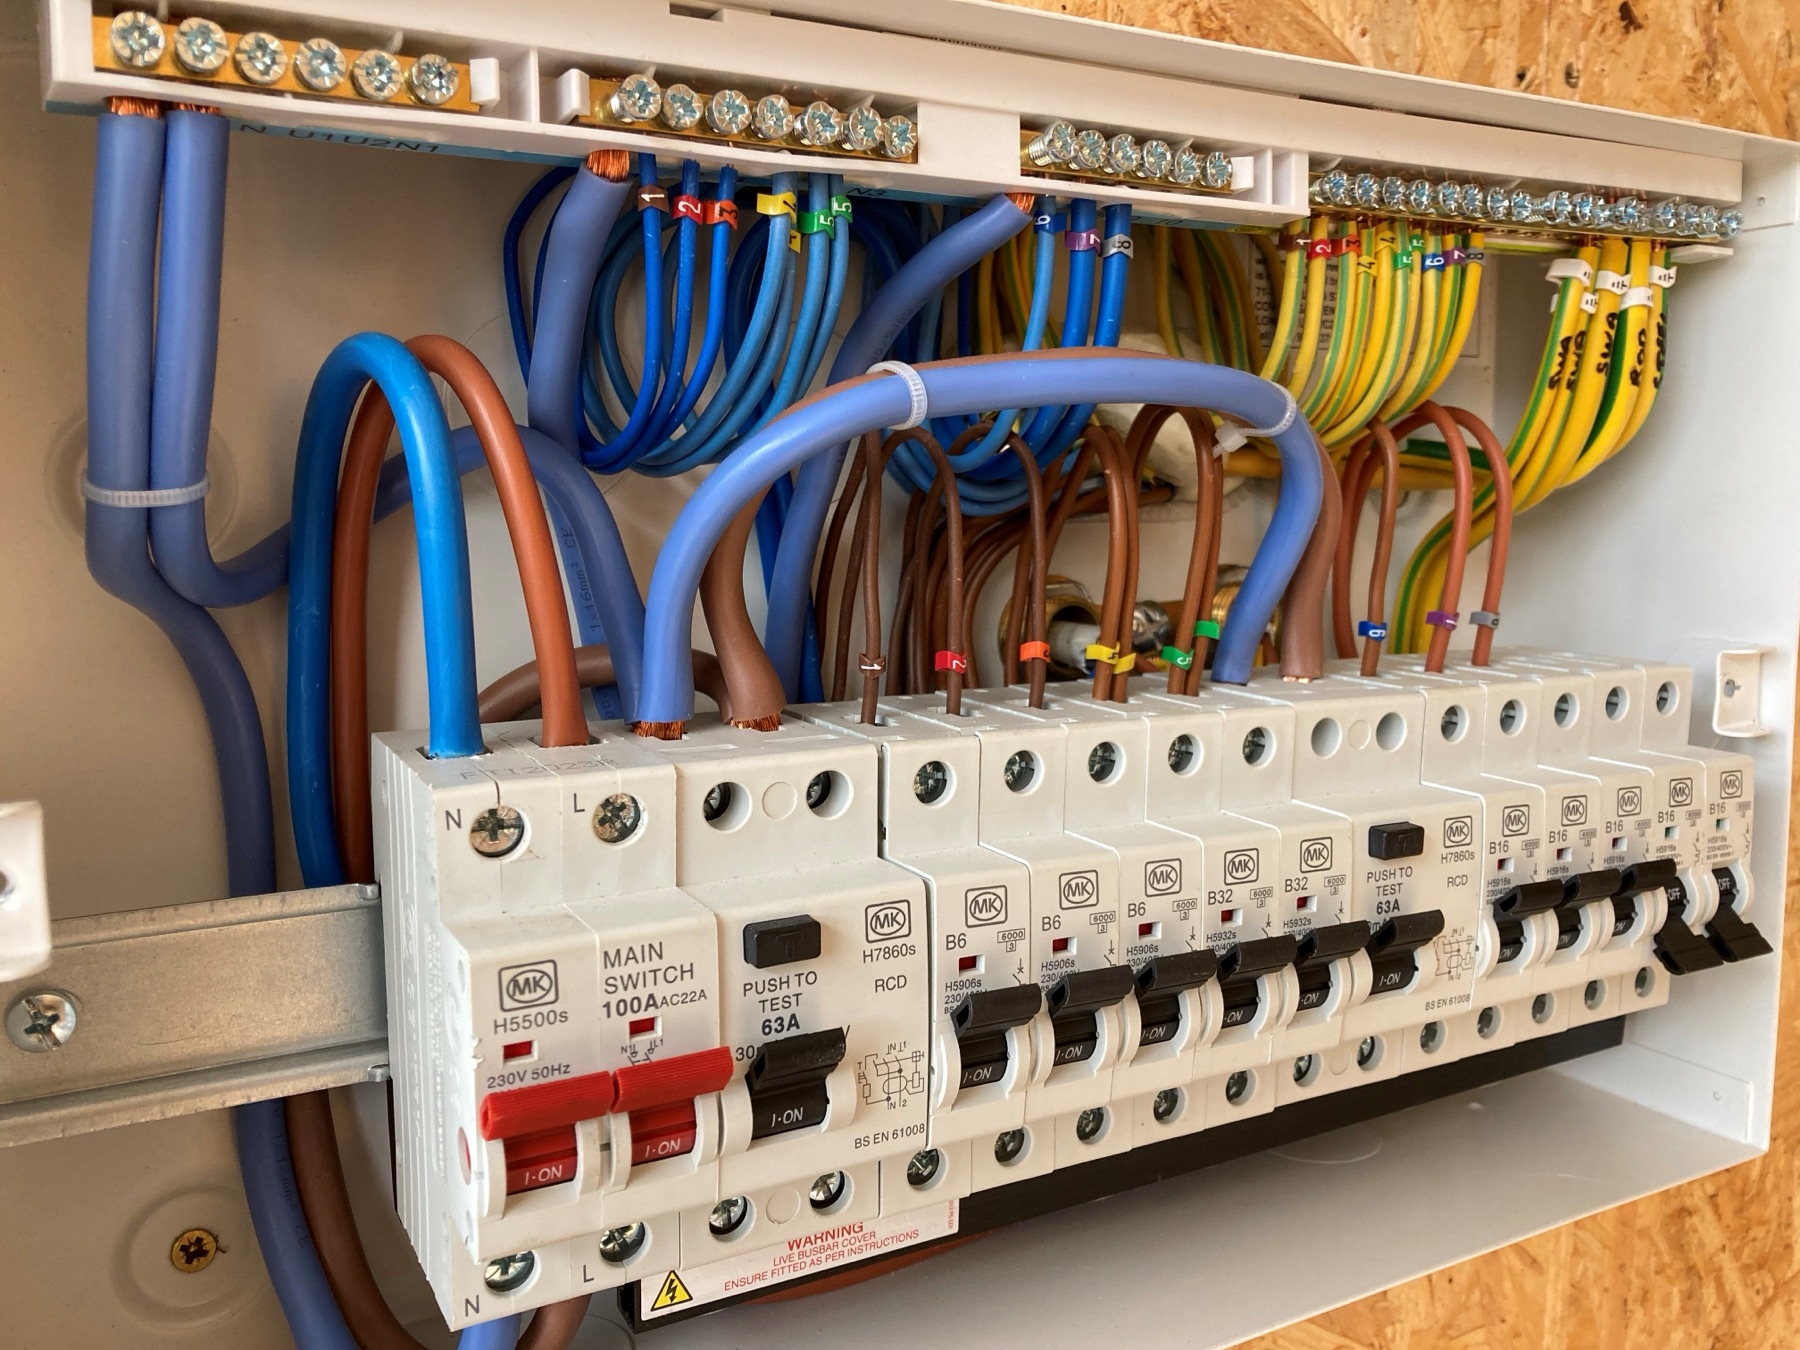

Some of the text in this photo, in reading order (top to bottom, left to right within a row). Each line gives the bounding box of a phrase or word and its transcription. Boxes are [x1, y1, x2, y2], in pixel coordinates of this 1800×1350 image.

[641, 193, 665, 202] 1
[678, 201, 701, 214] 2
[719, 206, 738, 220] 3
[836, 202, 852, 213] 5
[820, 214, 834, 226] 5
[1113, 240, 1131, 249] 8
[1296, 238, 1311, 246] 1
[1316, 244, 1332, 253] 2
[1413, 238, 1424, 247] 5
[1402, 255, 1413, 264] 5
[1425, 257, 1444, 266] 6
[1453, 249, 1466, 260] 7
[1466, 252, 1484, 260] 8
[1357, 261, 1375, 270] 4
[952, 660, 966, 670] 2
[1724, 778, 1739, 790] MK
[1673, 786, 1688, 798] MK
[573, 792, 586, 813] L
[1622, 795, 1637, 807] MK
[1567, 804, 1582, 817] MK
[1710, 802, 1726, 815] B16
[445, 808, 462, 831] N
[1508, 813, 1524, 827] MK
[1658, 810, 1675, 823] B16
[1449, 824, 1467, 838] MK
[1606, 820, 1623, 833] B16
[1549, 829, 1567, 843] B16
[1489, 840, 1509, 854] B16
[1306, 847, 1326, 862] MK
[1441, 850, 1475, 864] H7860s
[1231, 858, 1252, 874] MK
[1151, 869, 1175, 886] MK
[1367, 866, 1413, 883] PUSH TO
[1447, 875, 1468, 888] RCD
[1067, 881, 1092, 898] MK
[1285, 876, 1308, 893] B32
[1376, 883, 1403, 897] TEST
[1208, 889, 1233, 906] B32
[1253, 888, 1272, 898] 6000
[973, 896, 999, 915] MK
[1127, 902, 1146, 918] B6
[1176, 900, 1196, 910] 6000
[1376, 899, 1400, 915] 63A
[874, 911, 902, 930] MK
[1042, 915, 1061, 932] B6
[1093, 913, 1114, 923] 6000
[946, 933, 967, 951] B6
[1001, 930, 1024, 941] 6000
[603, 941, 664, 970] MAIN
[863, 943, 916, 964] H7860s
[1126, 943, 1159, 957] H5906s
[1041, 958, 1075, 972] H5906s
[511, 973, 547, 997] MK
[604, 962, 695, 995] SWITCH
[743, 970, 818, 997] PUSH TO
[874, 974, 908, 994] RCD
[945, 978, 982, 992] H5906s
[758, 992, 803, 1014] TEST
[1425, 1001, 1435, 1011] BS
[1437, 998, 1447, 1008] EN
[493, 1010, 569, 1035] H5500s
[761, 1013, 800, 1036] 63A
[486, 1062, 571, 1089] 230V 50Hz
[854, 1123, 925, 1150] BS EN 61008
[787, 1221, 864, 1252] WARNING
[773, 1231, 876, 1267] LIVE BUSBAR COVER
[724, 1229, 919, 1291] ENSURE FITTED AS PER INSTRUCTIONS
[582, 1264, 595, 1283] L
[464, 1295, 480, 1317] N
